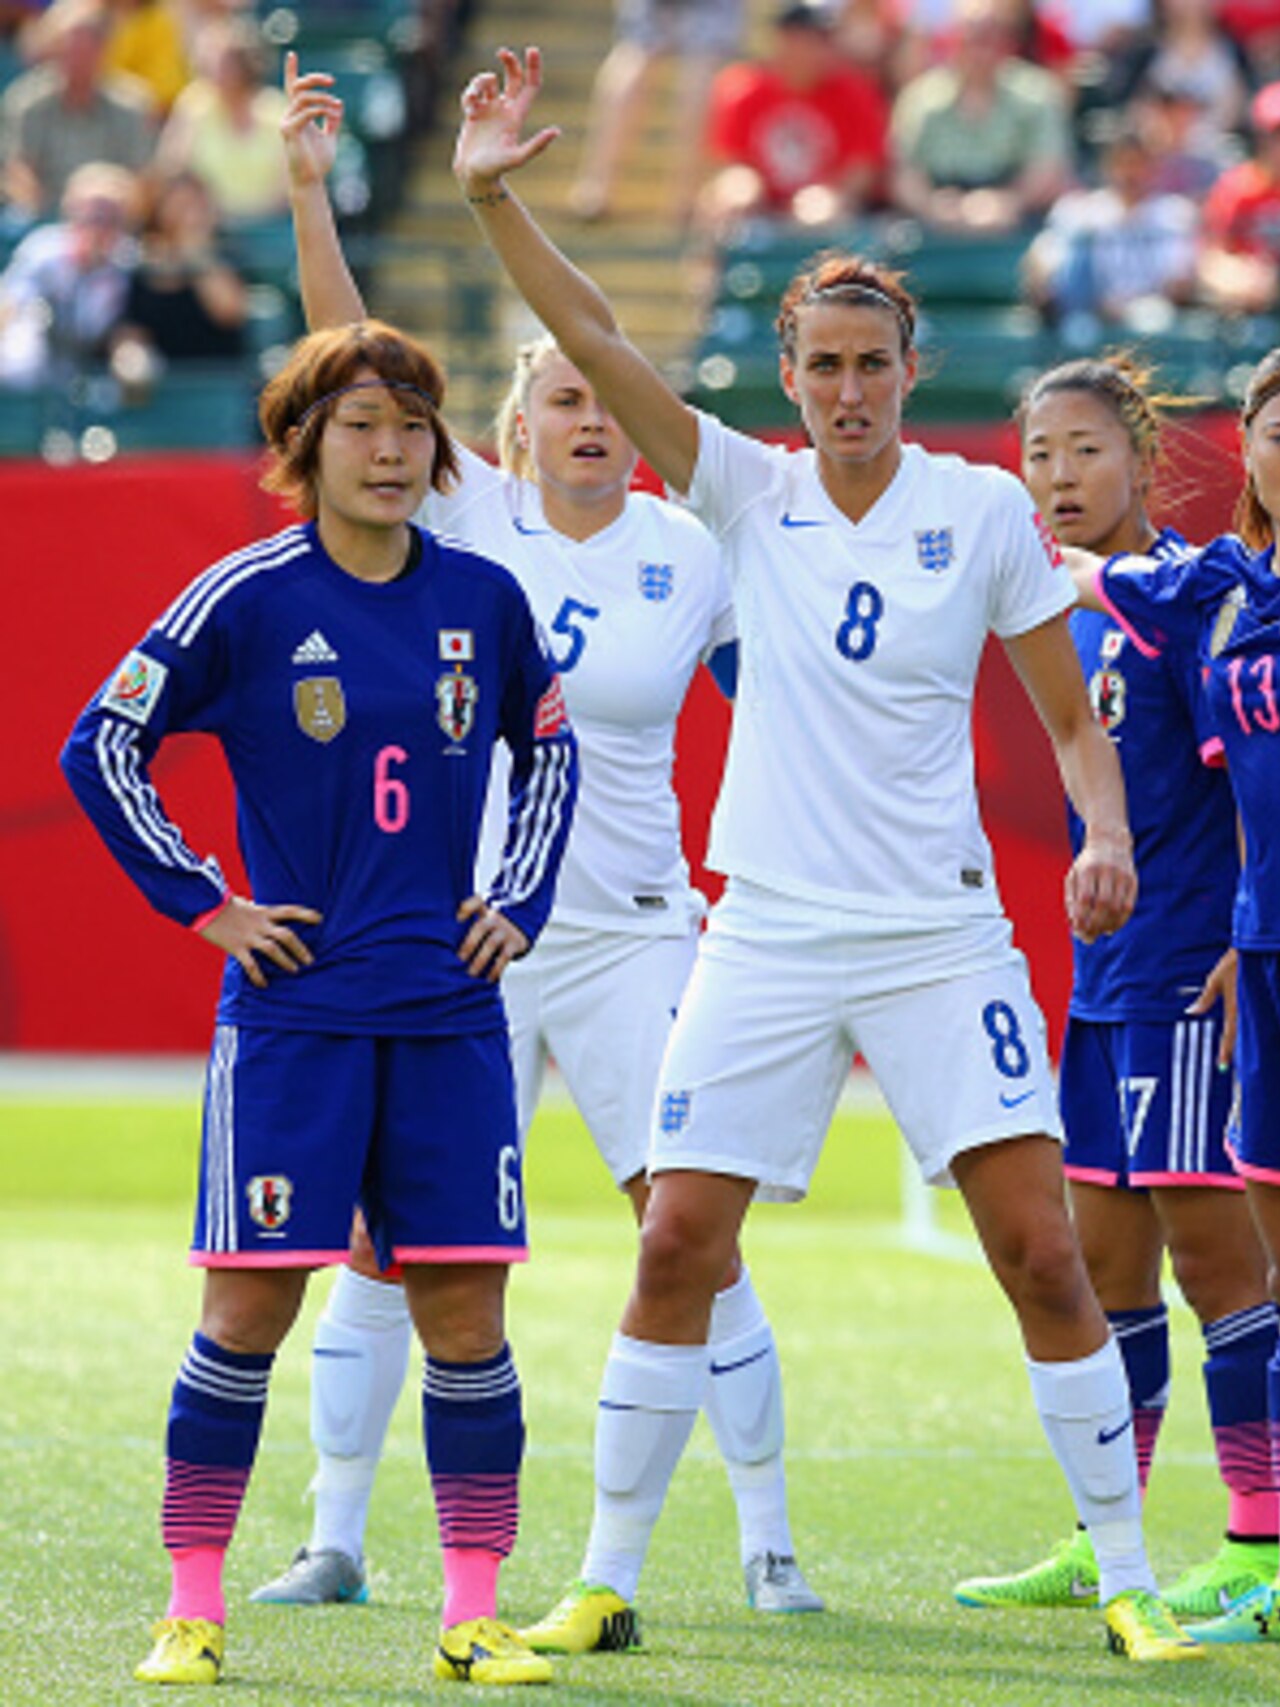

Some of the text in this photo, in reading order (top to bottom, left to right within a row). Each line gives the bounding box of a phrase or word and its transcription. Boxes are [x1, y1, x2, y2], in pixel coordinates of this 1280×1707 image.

[551, 597, 600, 673] 5
[835, 581, 884, 663] 8
[374, 745, 409, 833] 6
[981, 999, 1031, 1079] 8
[498, 1145, 520, 1231] 6
